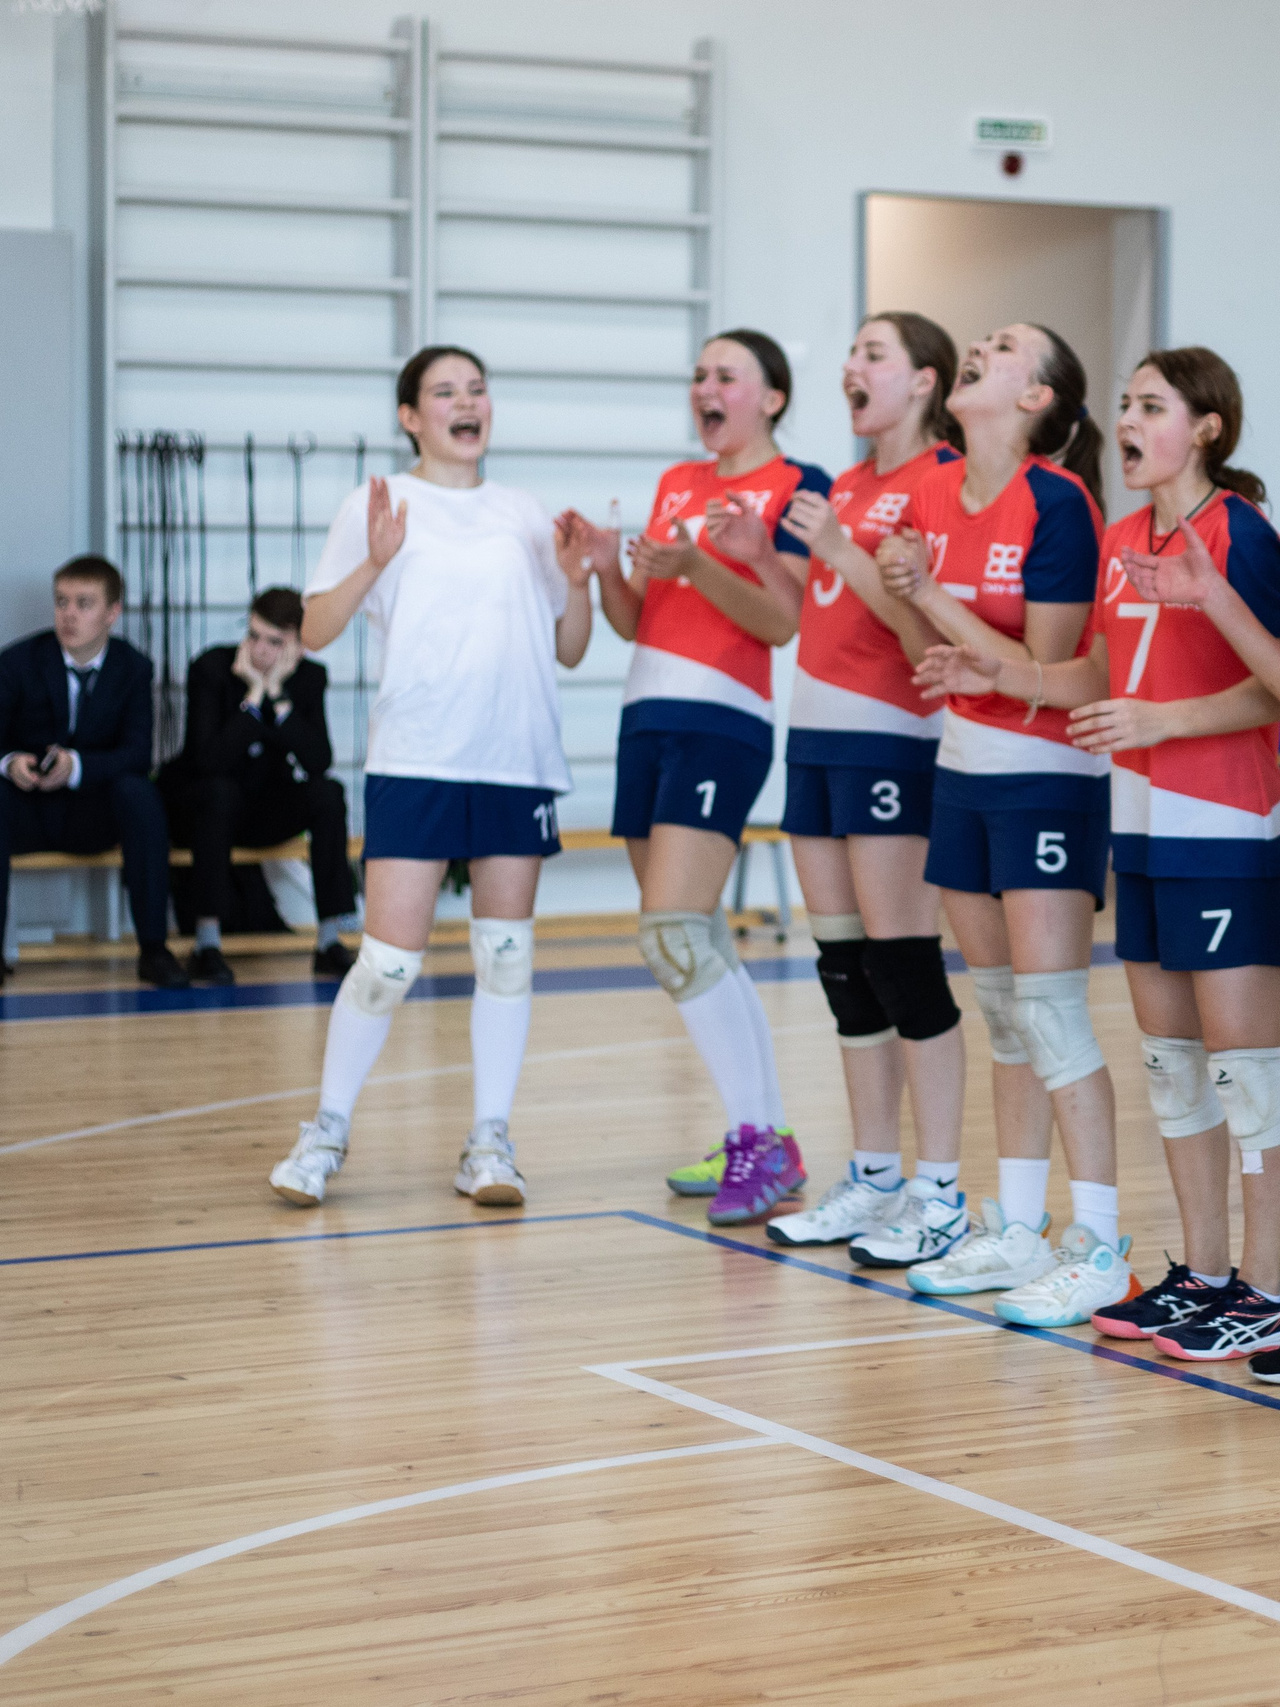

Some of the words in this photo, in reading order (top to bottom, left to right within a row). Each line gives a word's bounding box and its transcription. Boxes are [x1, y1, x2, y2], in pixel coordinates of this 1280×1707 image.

[1117, 602, 1161, 695] 7
[696, 780, 717, 818] 1
[870, 780, 902, 821] 3
[1035, 831, 1068, 874] 5
[1201, 908, 1232, 952] 7
